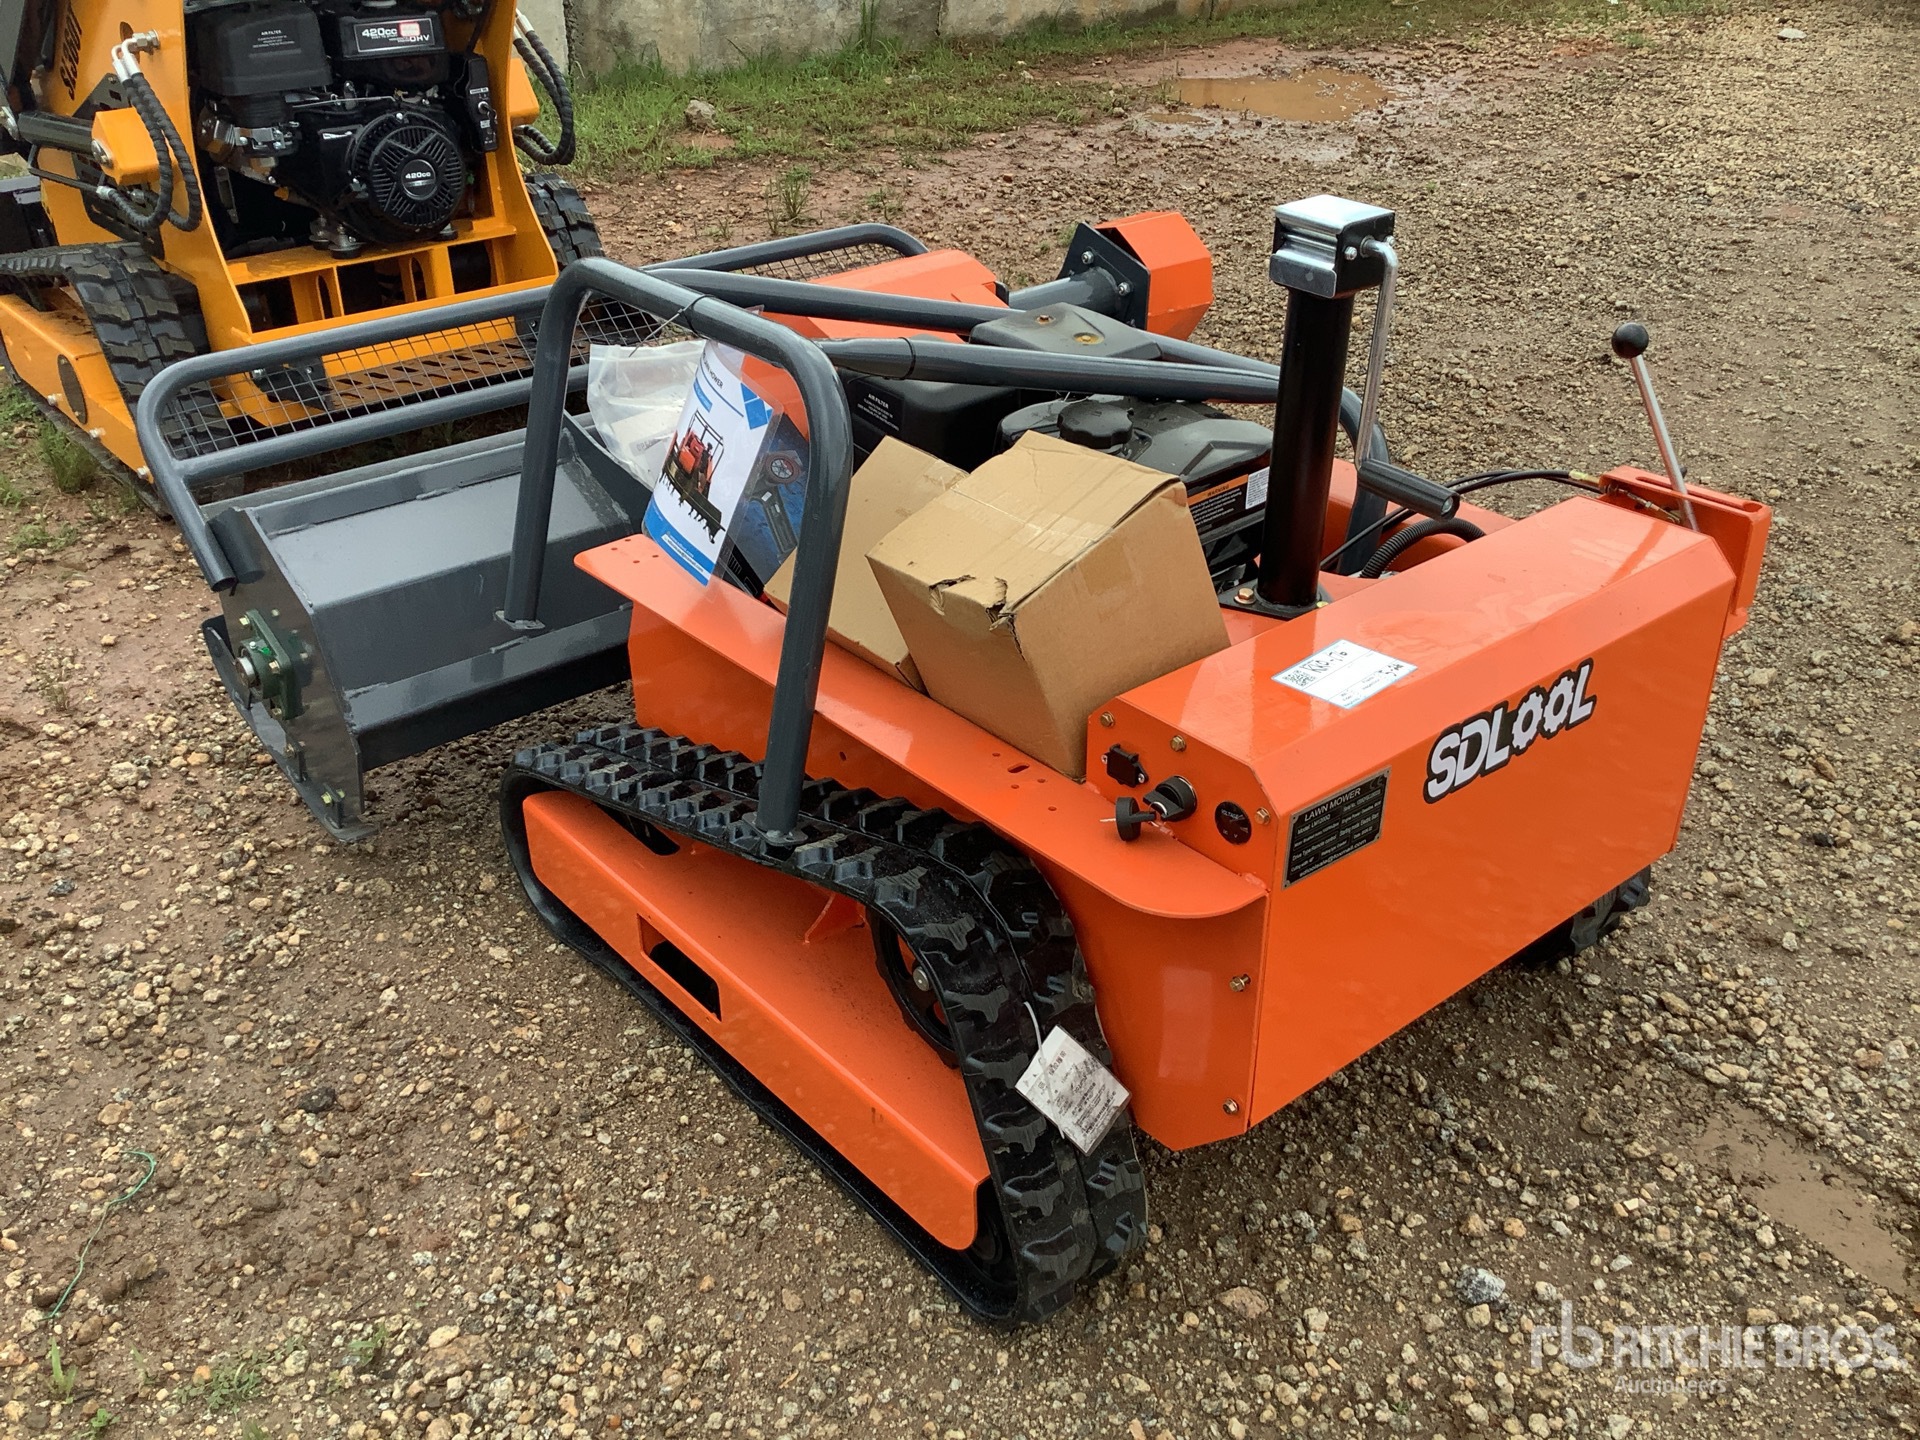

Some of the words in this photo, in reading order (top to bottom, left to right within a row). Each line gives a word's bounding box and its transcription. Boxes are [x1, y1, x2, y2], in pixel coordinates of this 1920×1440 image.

[362, 27, 397, 37] 420cc
[409, 34, 430, 42] OHV
[405, 171, 431, 179] 420cc
[1427, 664, 1594, 798] SDLOOL
[1304, 804, 1328, 821] LAWN
[1329, 787, 1361, 808] MOWER
